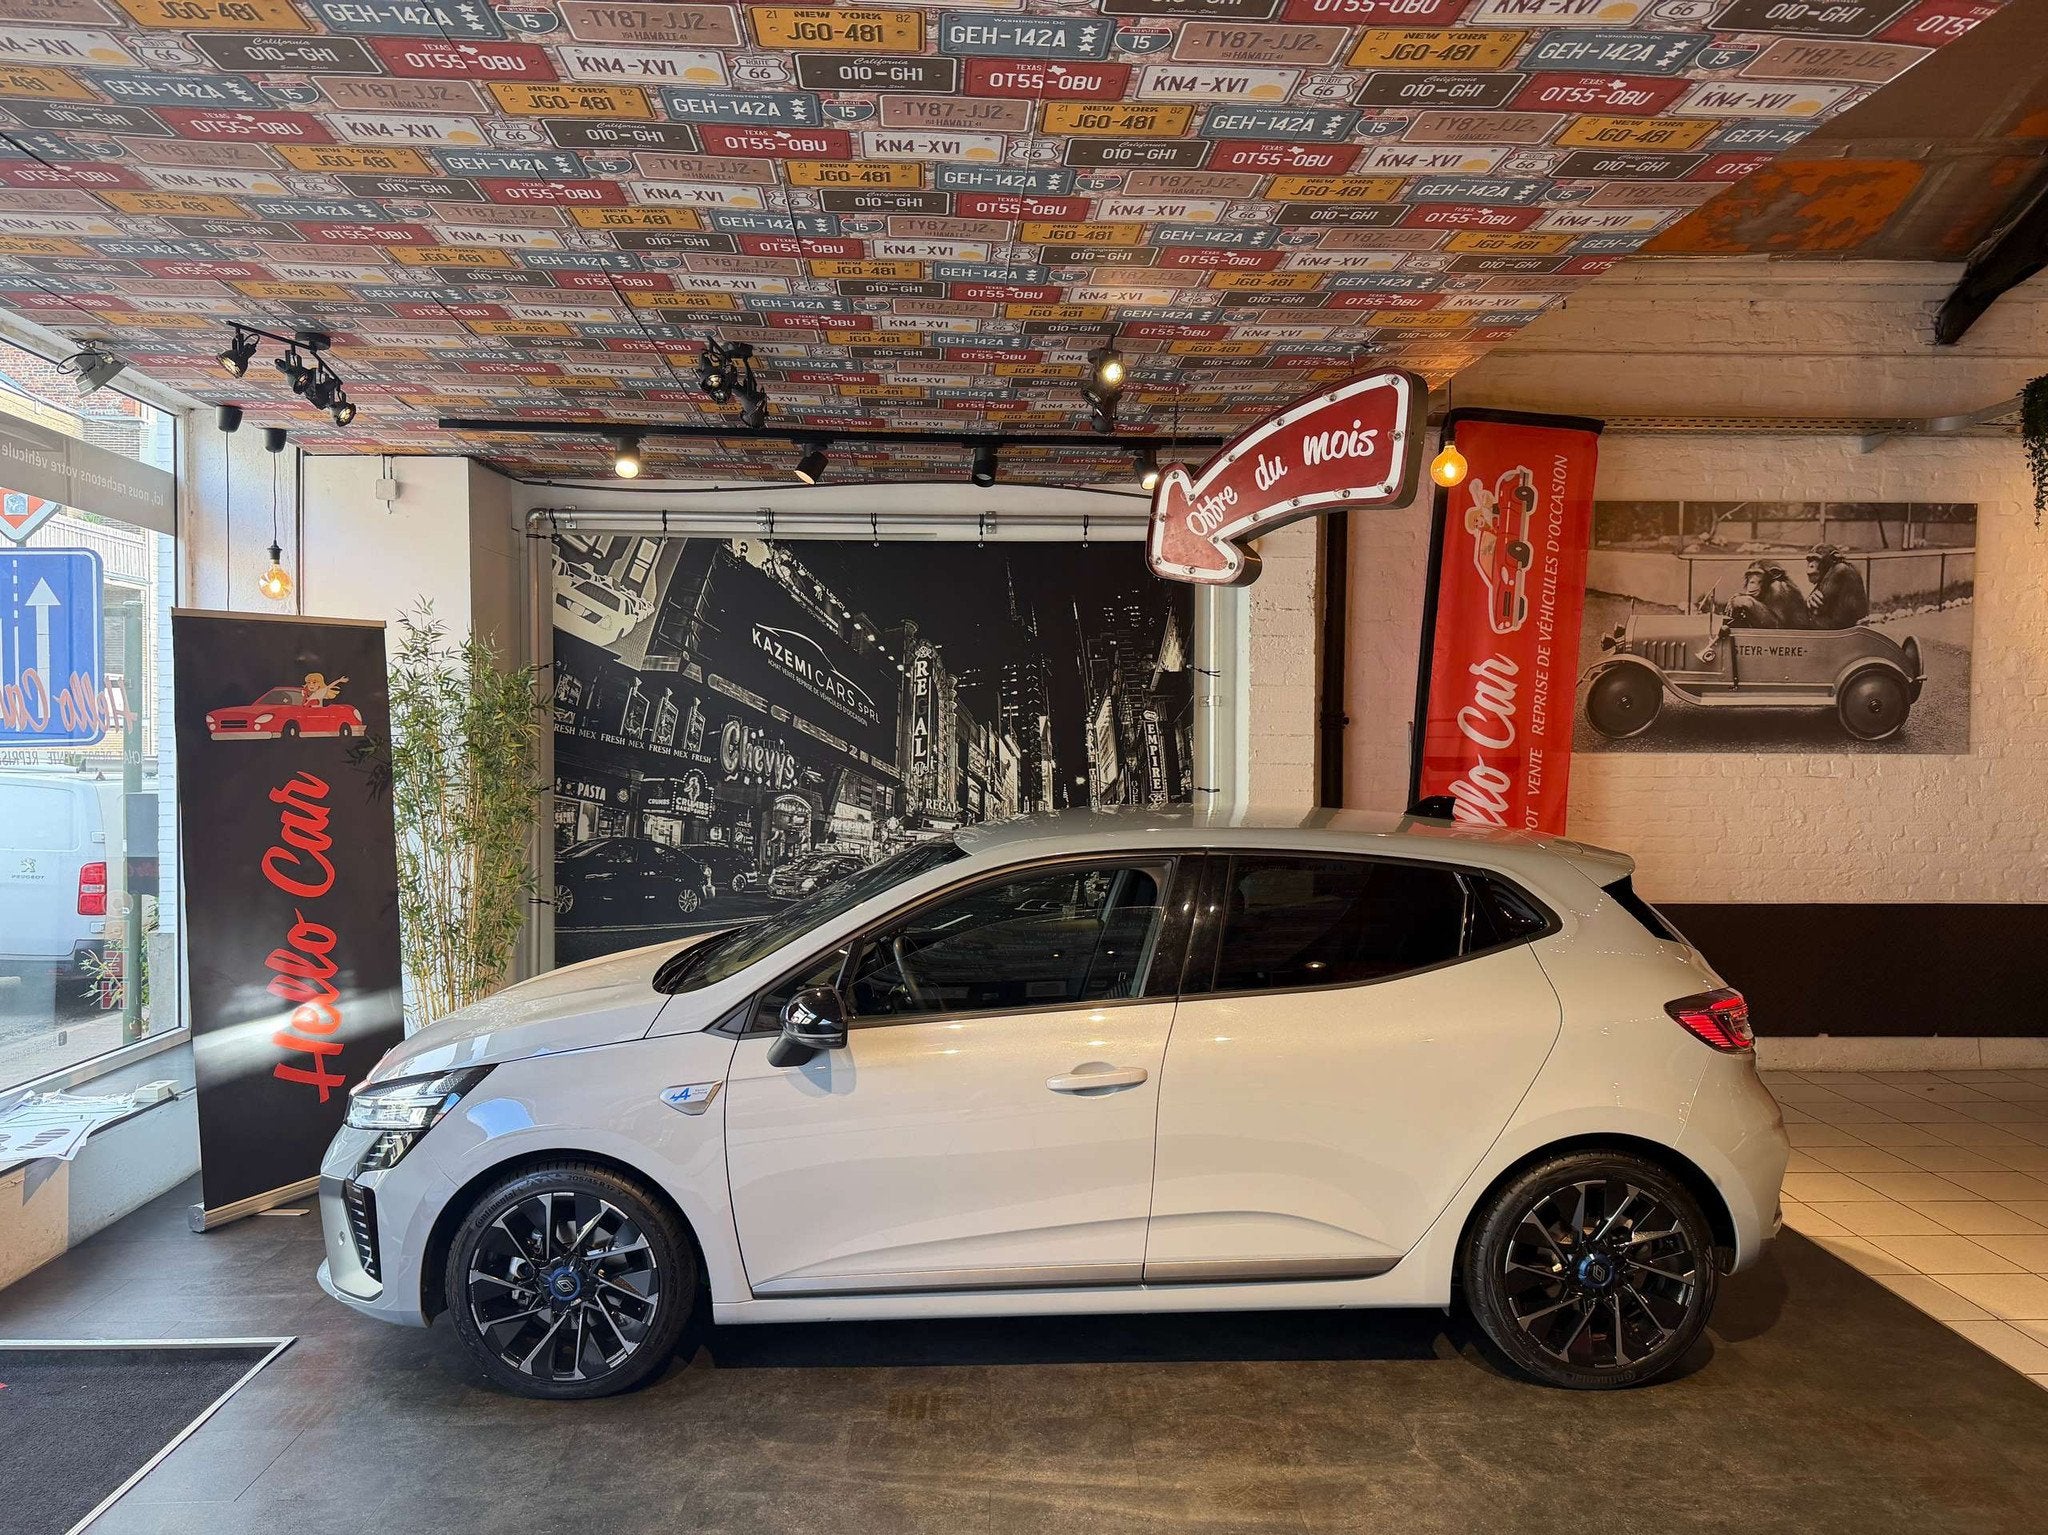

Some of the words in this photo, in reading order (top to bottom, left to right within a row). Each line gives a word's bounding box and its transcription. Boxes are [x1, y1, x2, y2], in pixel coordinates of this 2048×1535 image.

[793, 10, 830, 18] NEW
[838, 11, 882, 21] YORK
[1668, 2, 1697, 16] 66
[515, 13, 540, 28] 15
[252, 37, 311, 46] California
[950, 25, 1065, 47] GEH-142A
[1132, 35, 1151, 49] 15
[1403, 31, 1442, 39] NEW
[1444, 32, 1491, 41] YORK
[154, 48, 181, 61] 66
[422, 43, 452, 51] TEXAS
[1536, 40, 1656, 62] GEH-142A
[853, 57, 908, 66] California
[1708, 50, 1736, 64] 15
[748, 67, 772, 79] 66
[1016, 63, 1042, 71] TEXAS
[1422, 75, 1477, 83] California
[1578, 78, 1605, 86] TEXAS
[102, 80, 226, 99] GEH-142A
[278, 88, 304, 100] 15
[1312, 84, 1334, 96] 66
[672, 98, 781, 116] GEH-142A
[838, 106, 857, 118] 15
[1211, 114, 1315, 132] GEH-142A
[1369, 121, 1389, 133] 15
[505, 130, 527, 140] 66
[1022, 148, 1042, 158] 66
[1515, 159, 1537, 169] 66
[944, 172, 1037, 187] GEH-142A
[1254, 453, 1288, 491] du
[1303, 420, 1378, 466] mois
[1537, 553, 1559, 643] VÉHICULES
[1536, 644, 1551, 668] DE
[752, 627, 812, 681] KAZEMI
[815, 669, 856, 707] CARS
[857, 701, 881, 724] SPRL
[1457, 652, 1520, 750] Car
[1531, 667, 1549, 737] REPRISE
[914, 660, 929, 758] REGAL
[578, 728, 597, 740] MEX
[600, 733, 626, 746] FRESH
[628, 738, 645, 750] MEX
[648, 743, 671, 755] FRESH
[673, 748, 688, 760] MEX
[691, 753, 712, 764] FRESH
[720, 720, 795, 790] Chevys
[1146, 723, 1162, 790] EMPIRE
[1527, 747, 1543, 796] VENTE
[577, 782, 606, 801] PASTA
[675, 796, 710, 811] CRUMBS
[261, 770, 337, 898] Car
[264, 907, 347, 1104] Hello
